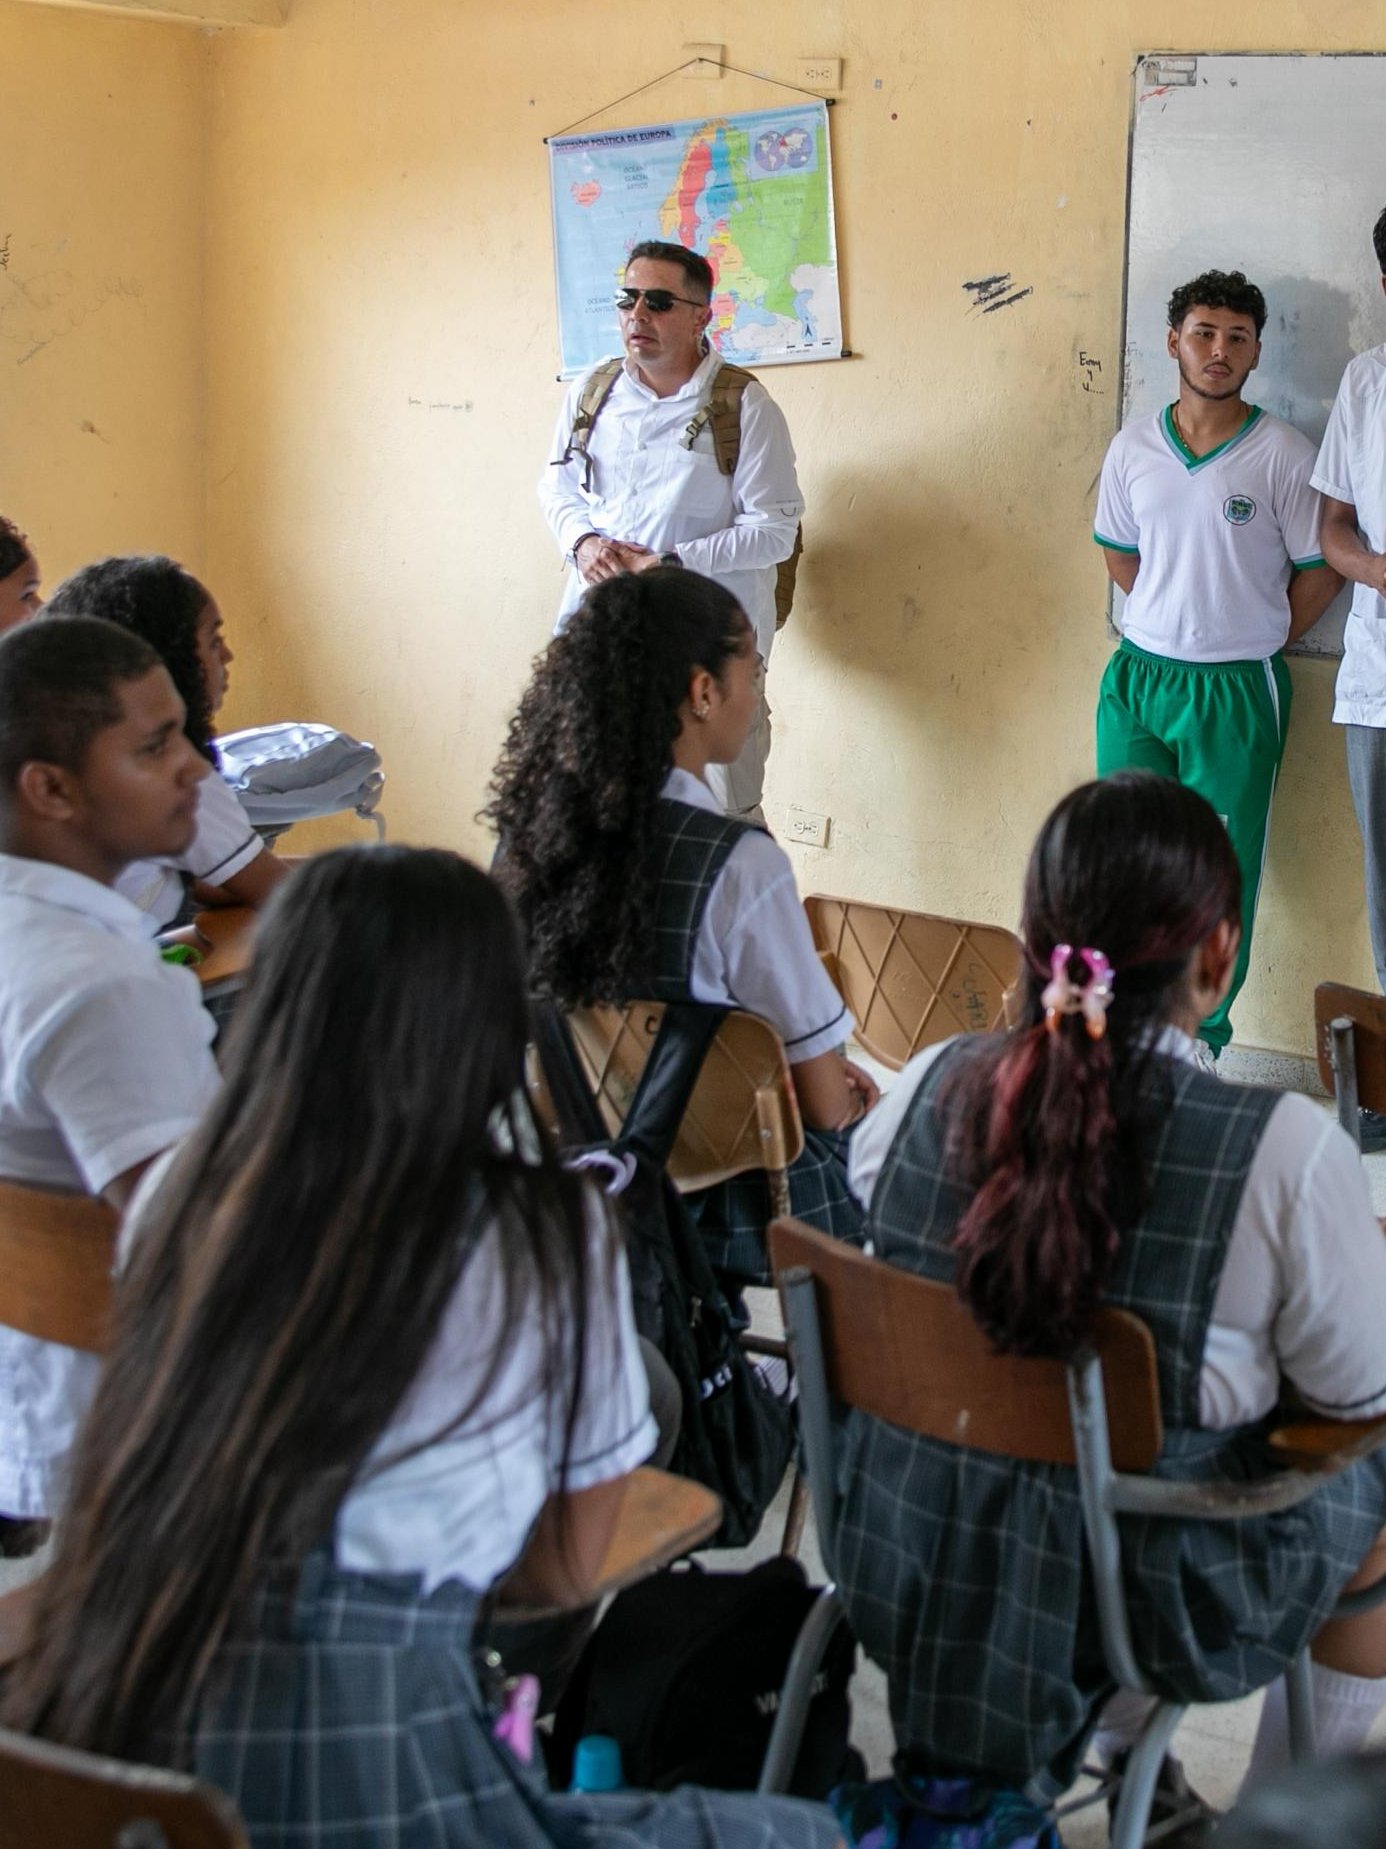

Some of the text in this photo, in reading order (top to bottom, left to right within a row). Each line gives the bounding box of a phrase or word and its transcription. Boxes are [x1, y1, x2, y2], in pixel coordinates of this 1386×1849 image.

[591, 135, 627, 147] POLÍTICA
[628, 134, 639, 142] DE
[640, 130, 672, 141] EUROPA
